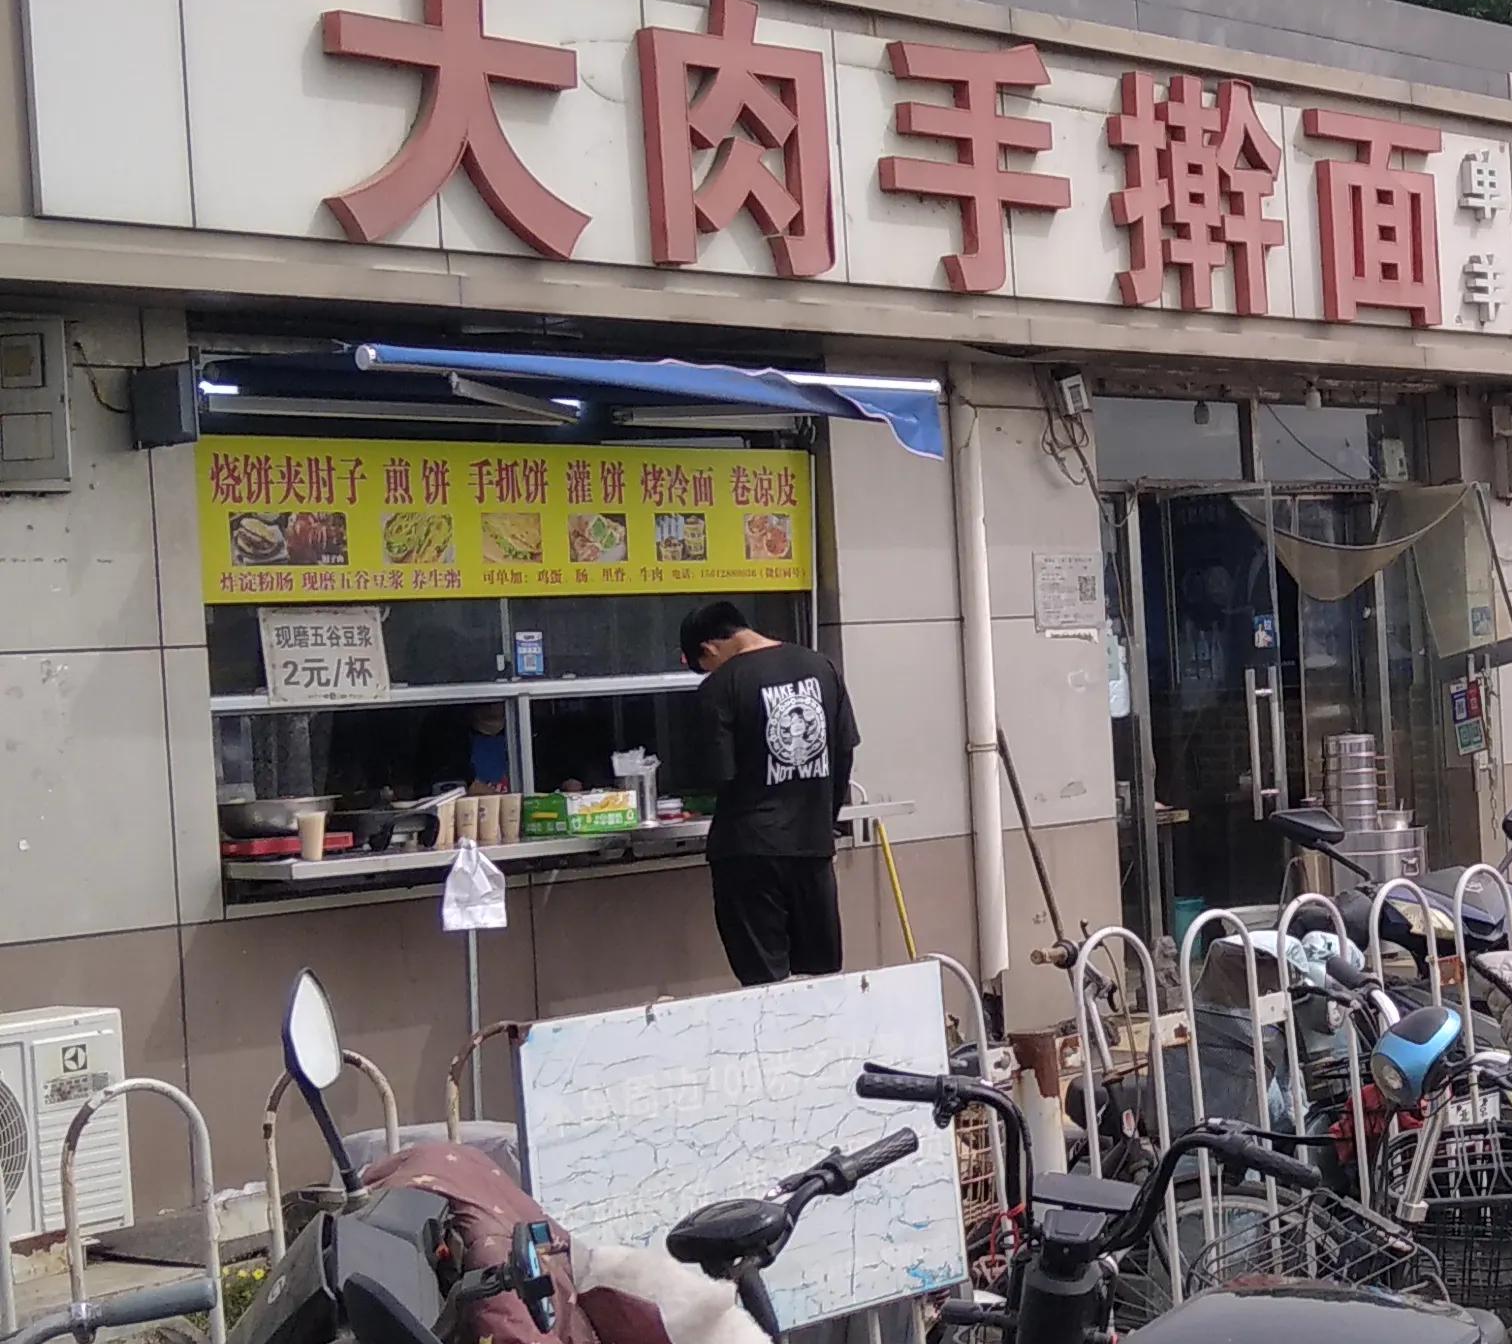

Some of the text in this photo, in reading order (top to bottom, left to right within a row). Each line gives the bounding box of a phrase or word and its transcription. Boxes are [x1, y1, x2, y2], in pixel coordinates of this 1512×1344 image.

[210, 452, 800, 508] 烧饼夹肘子 煎饼 手抓饼 灌饼 烤冷面 卷凉皮
[274, 625, 373, 649] 现磨五谷豆浆
[281, 657, 373, 688] 2元/杯
[762, 683, 796, 717] MAKE
[766, 753, 796, 786] NOT
